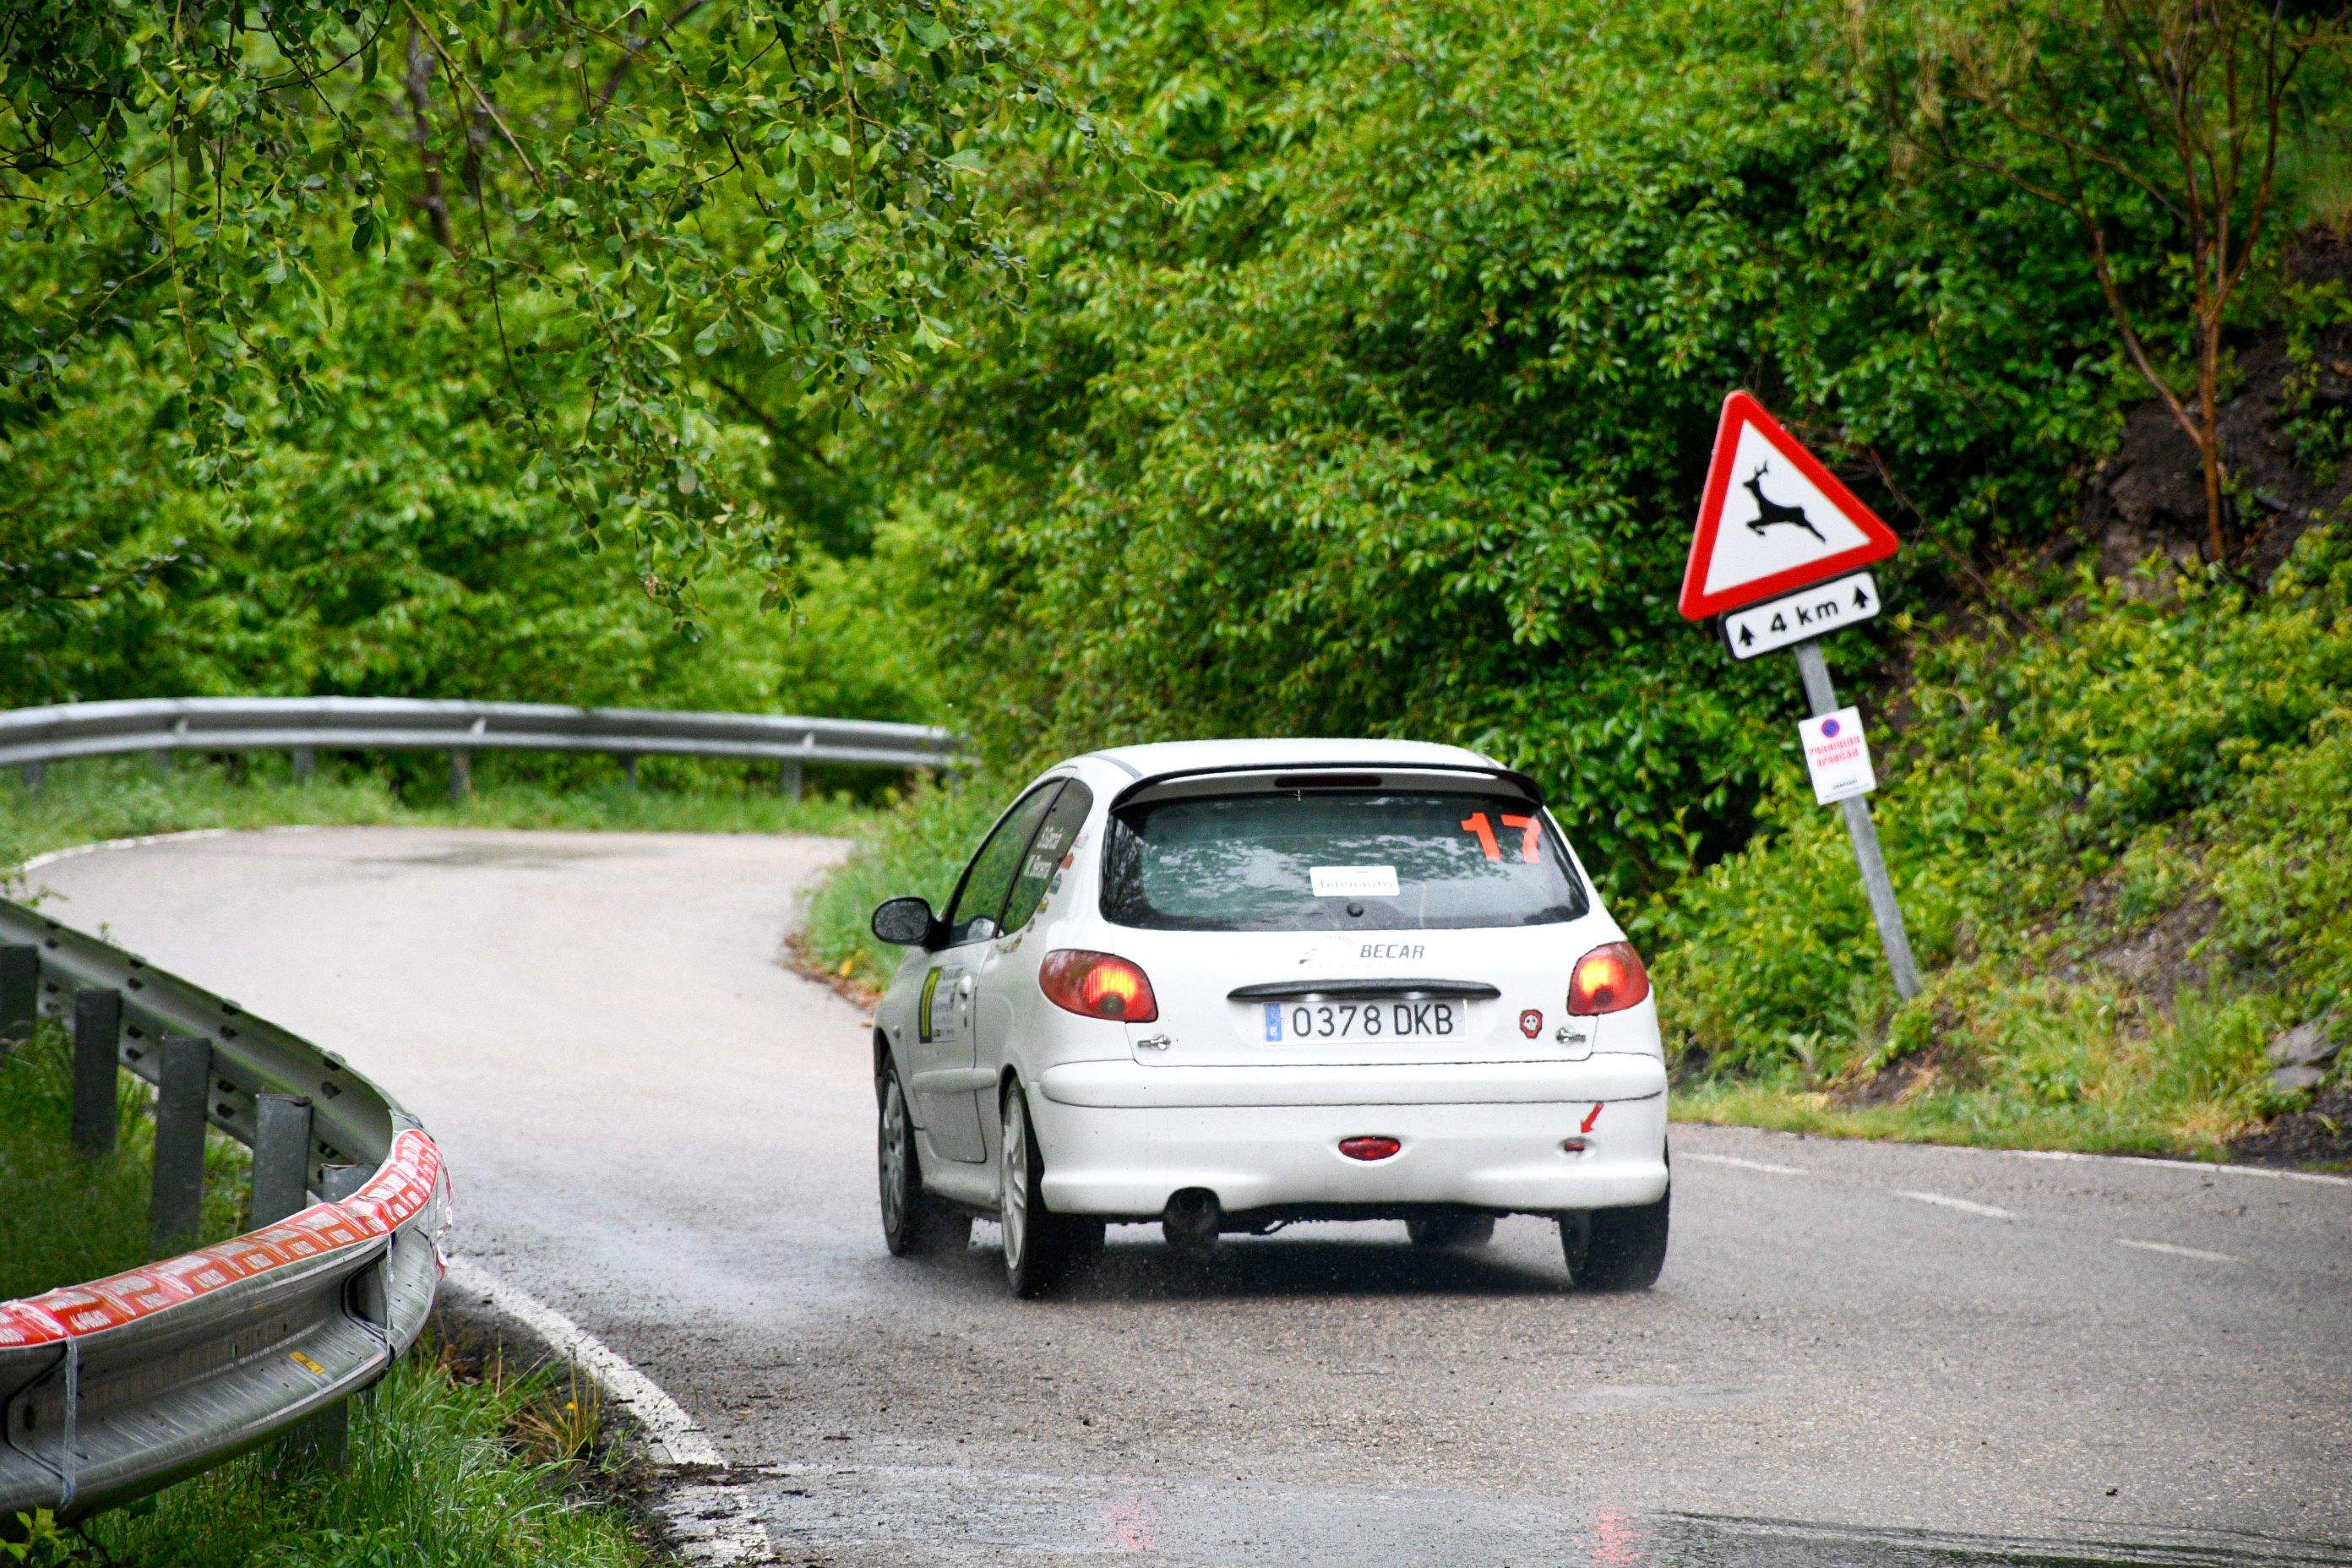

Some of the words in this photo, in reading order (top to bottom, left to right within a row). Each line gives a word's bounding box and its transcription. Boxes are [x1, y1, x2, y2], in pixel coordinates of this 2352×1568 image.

[1770, 612, 1788, 632] 4
[1795, 601, 1838, 626] km
[1460, 812, 1542, 864] 17
[1359, 944, 1425, 960] BECAR
[1293, 1005, 1382, 1037] 0378
[1394, 1004, 1453, 1036] DKB
